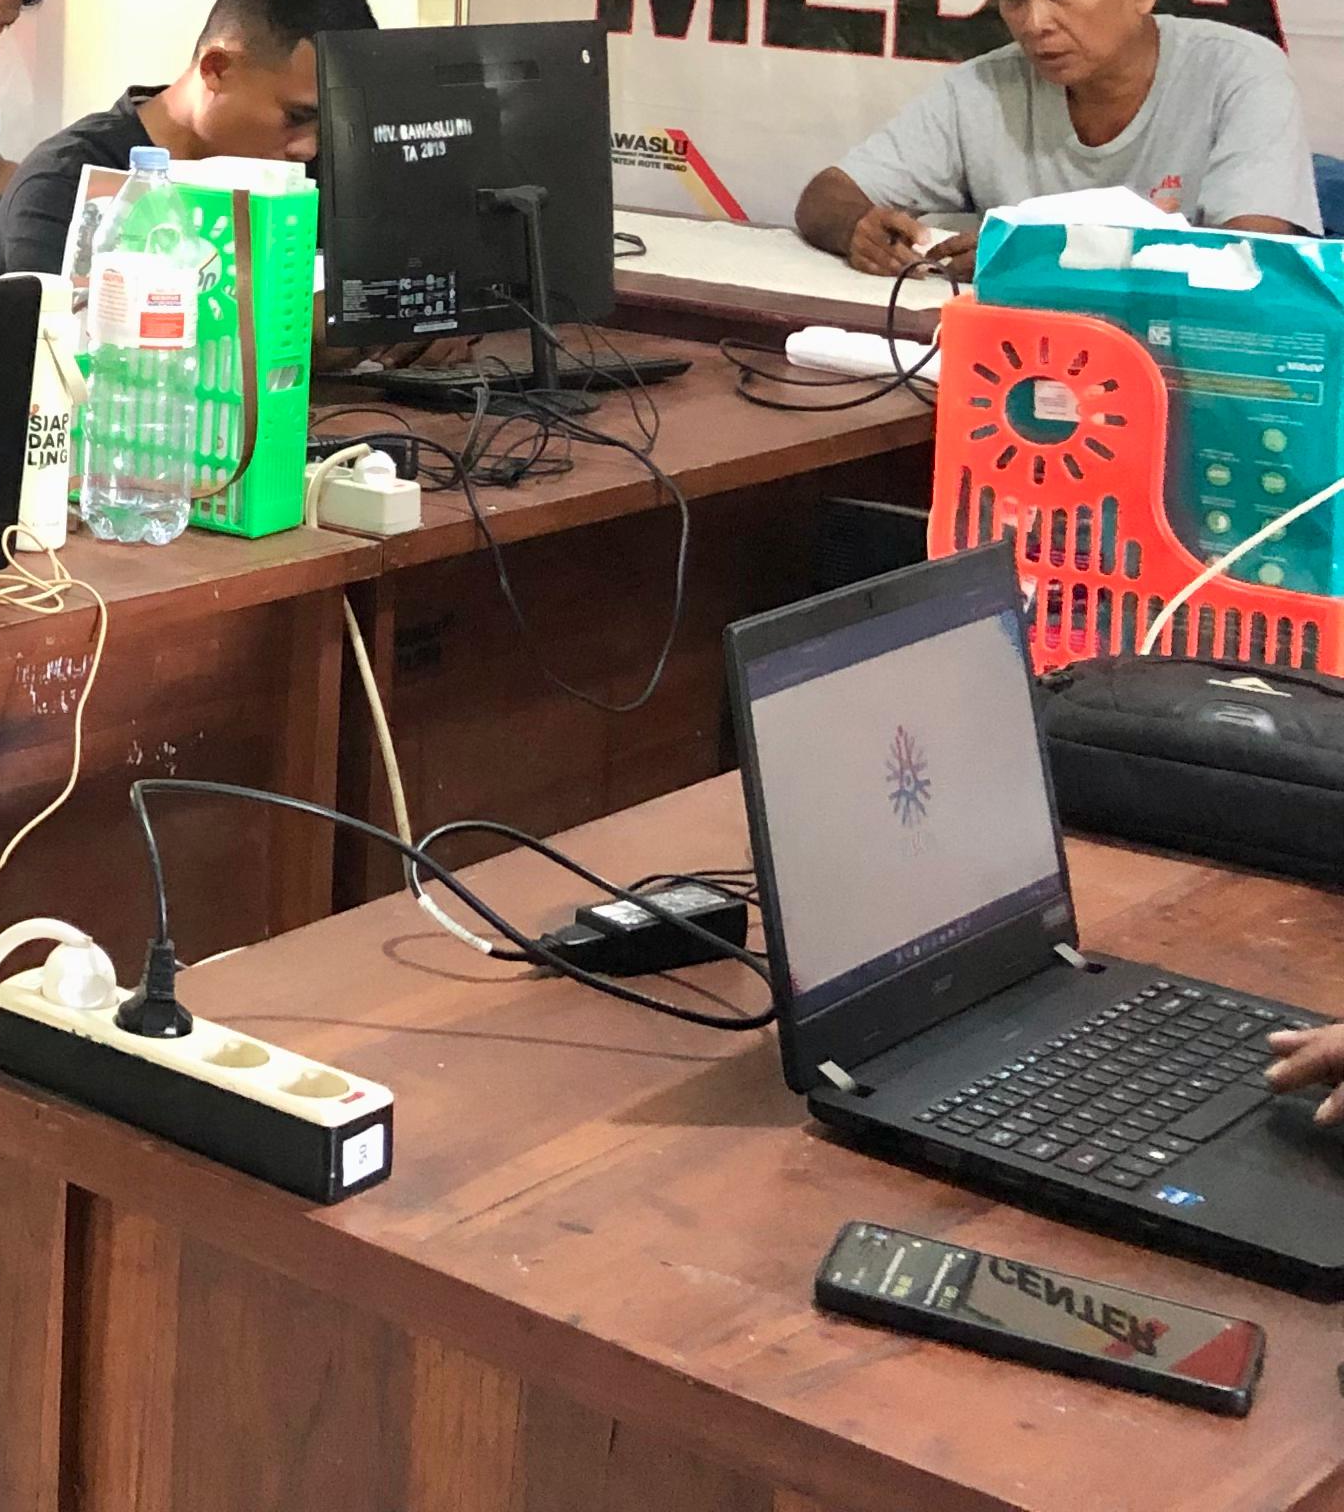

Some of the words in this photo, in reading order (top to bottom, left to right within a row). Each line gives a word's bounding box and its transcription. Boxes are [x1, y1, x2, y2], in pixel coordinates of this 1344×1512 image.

[400, 120, 454, 140] BAWASLU
[610, 133, 689, 155] WASLU
[402, 145, 418, 162] TA
[30, 413, 69, 431] SIAP
[28, 433, 65, 449] DAR
[28, 449, 68, 466] LING
